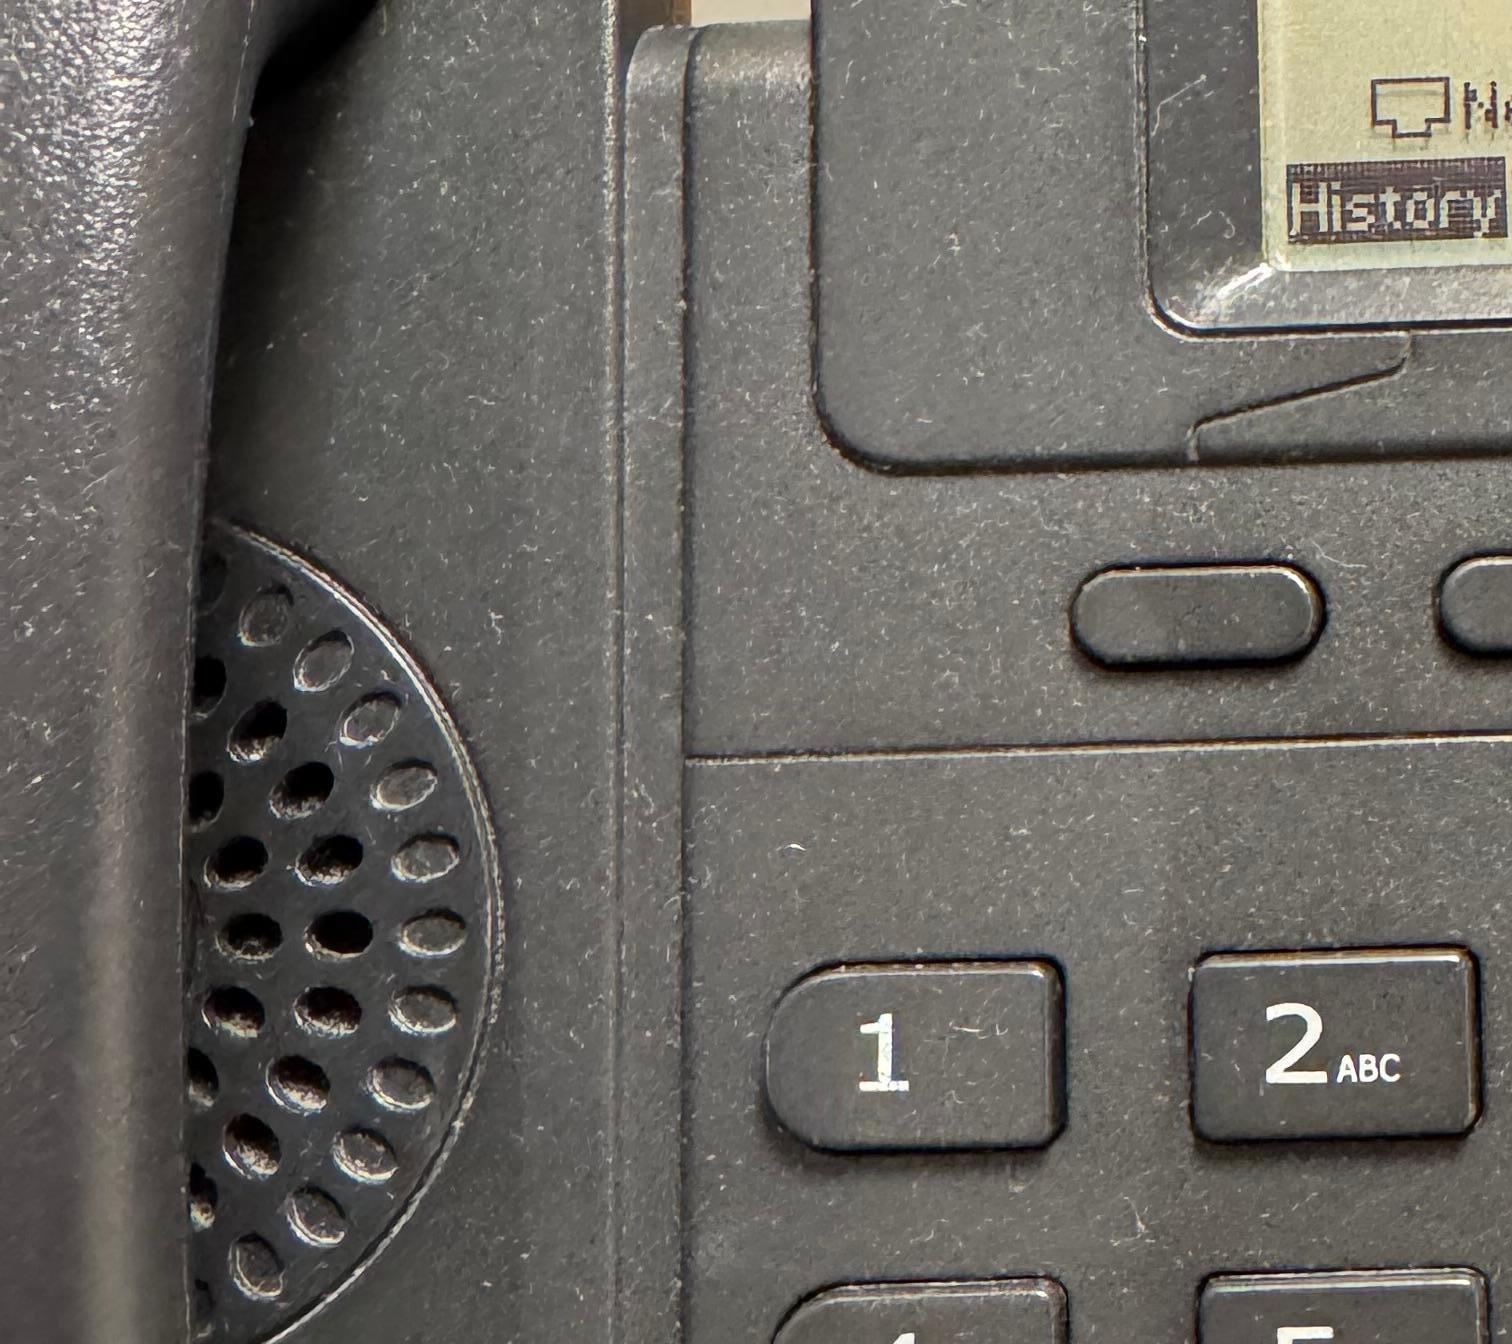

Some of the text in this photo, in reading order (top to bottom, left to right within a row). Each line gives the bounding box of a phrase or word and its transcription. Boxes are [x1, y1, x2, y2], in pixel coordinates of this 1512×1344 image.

[1291, 181, 1503, 238] History
[859, 1014, 909, 1092] 1
[1265, 1003, 1401, 1084] 2 ABC
